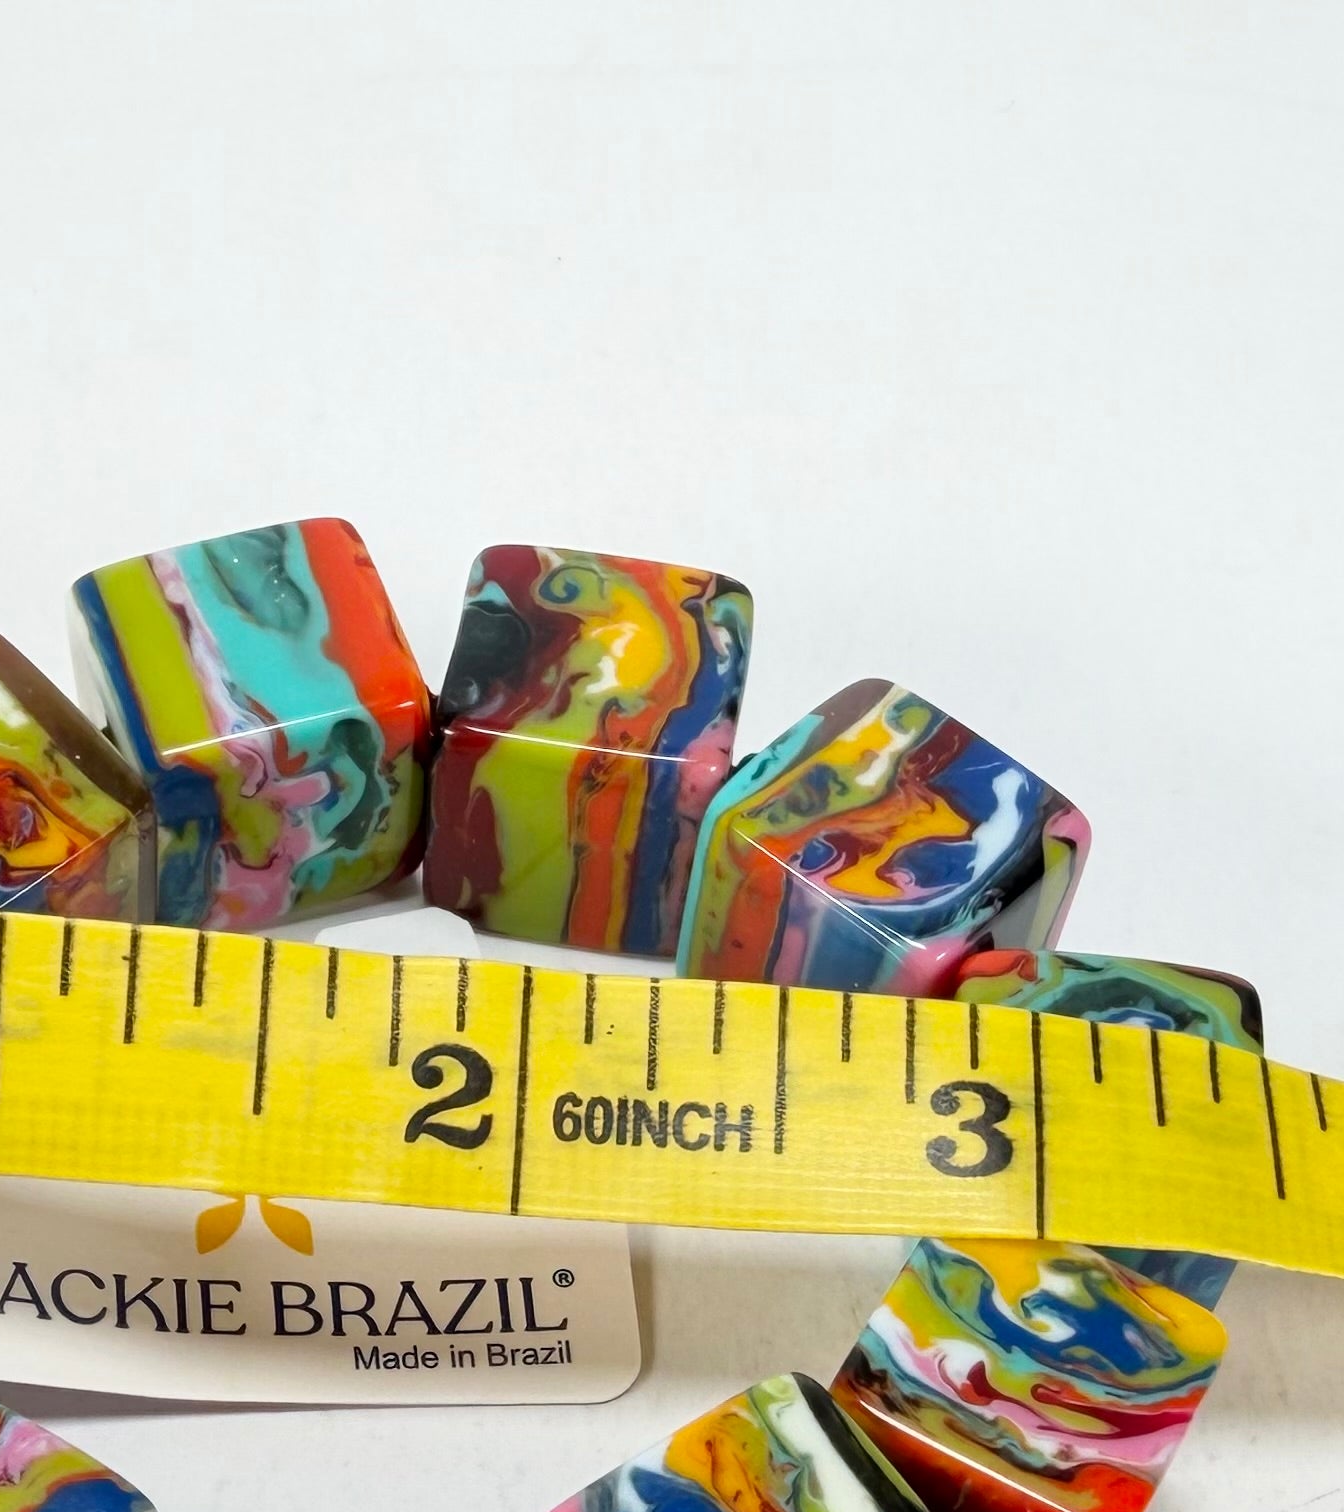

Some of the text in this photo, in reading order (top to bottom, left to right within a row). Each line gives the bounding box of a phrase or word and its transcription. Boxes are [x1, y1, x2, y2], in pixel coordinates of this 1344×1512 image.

[404, 1043, 493, 1150] 2
[551, 1091, 755, 1154] 60INCH
[925, 1080, 1014, 1179] 3
[352, 1339, 573, 1371] Made in Brazil
